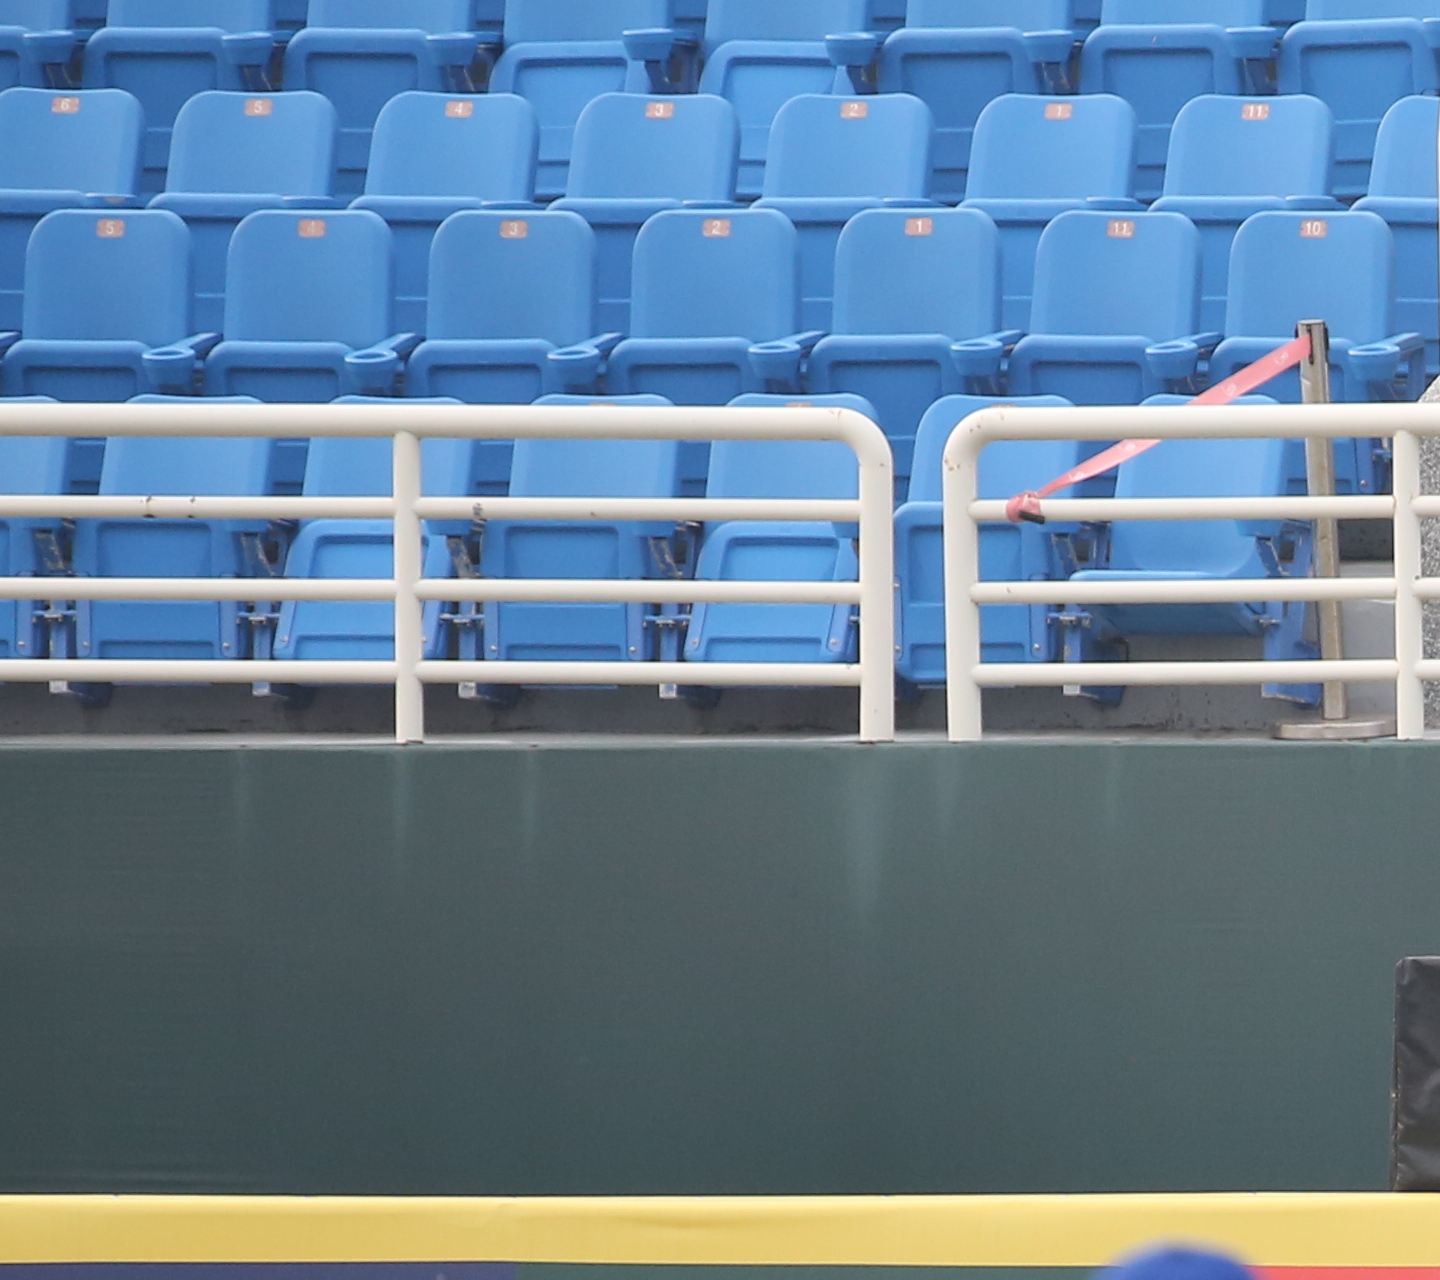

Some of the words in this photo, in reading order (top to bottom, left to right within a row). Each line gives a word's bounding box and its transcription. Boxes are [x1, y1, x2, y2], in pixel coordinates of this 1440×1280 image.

[60, 98, 71, 111] 6
[253, 100, 263, 114] 5
[454, 102, 464, 115] 4
[654, 103, 664, 117] 3
[848, 103, 859, 117] 2
[1249, 104, 1263, 117] 11
[105, 221, 115, 235] 5
[509, 222, 518, 237] 3
[711, 220, 721, 235] 2
[916, 219, 923, 233] 1
[1306, 221, 1321, 236] 10
